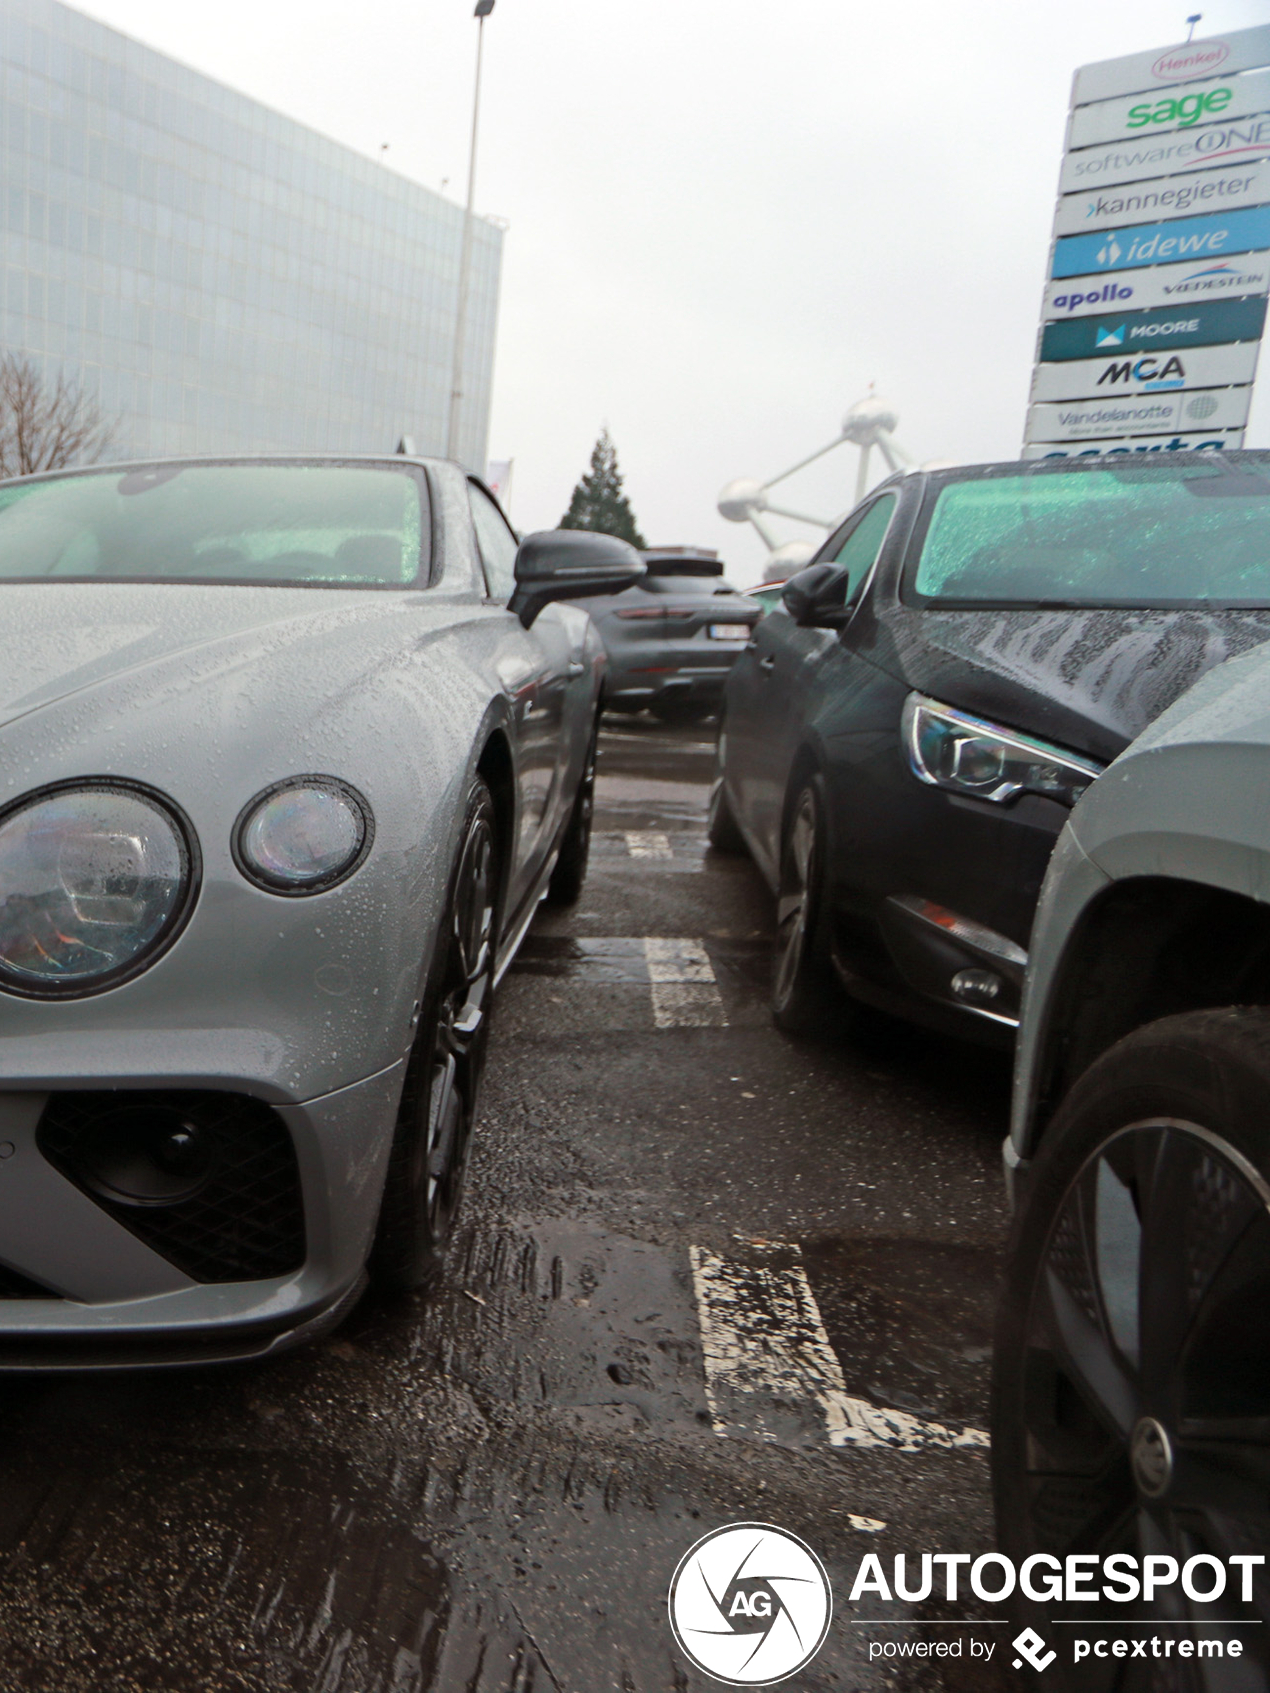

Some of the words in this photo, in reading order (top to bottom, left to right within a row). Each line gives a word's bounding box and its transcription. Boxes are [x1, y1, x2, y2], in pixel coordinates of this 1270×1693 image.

[1159, 49, 1223, 72] Henkel
[1126, 87, 1233, 128] sage
[1095, 174, 1257, 218] kannegieter
[1126, 230, 1229, 262] idewe
[1053, 283, 1134, 311] apollo
[1130, 318, 1201, 339] MOORE
[1096, 356, 1186, 386] MCA
[1058, 404, 1173, 426] Vandelanotte
